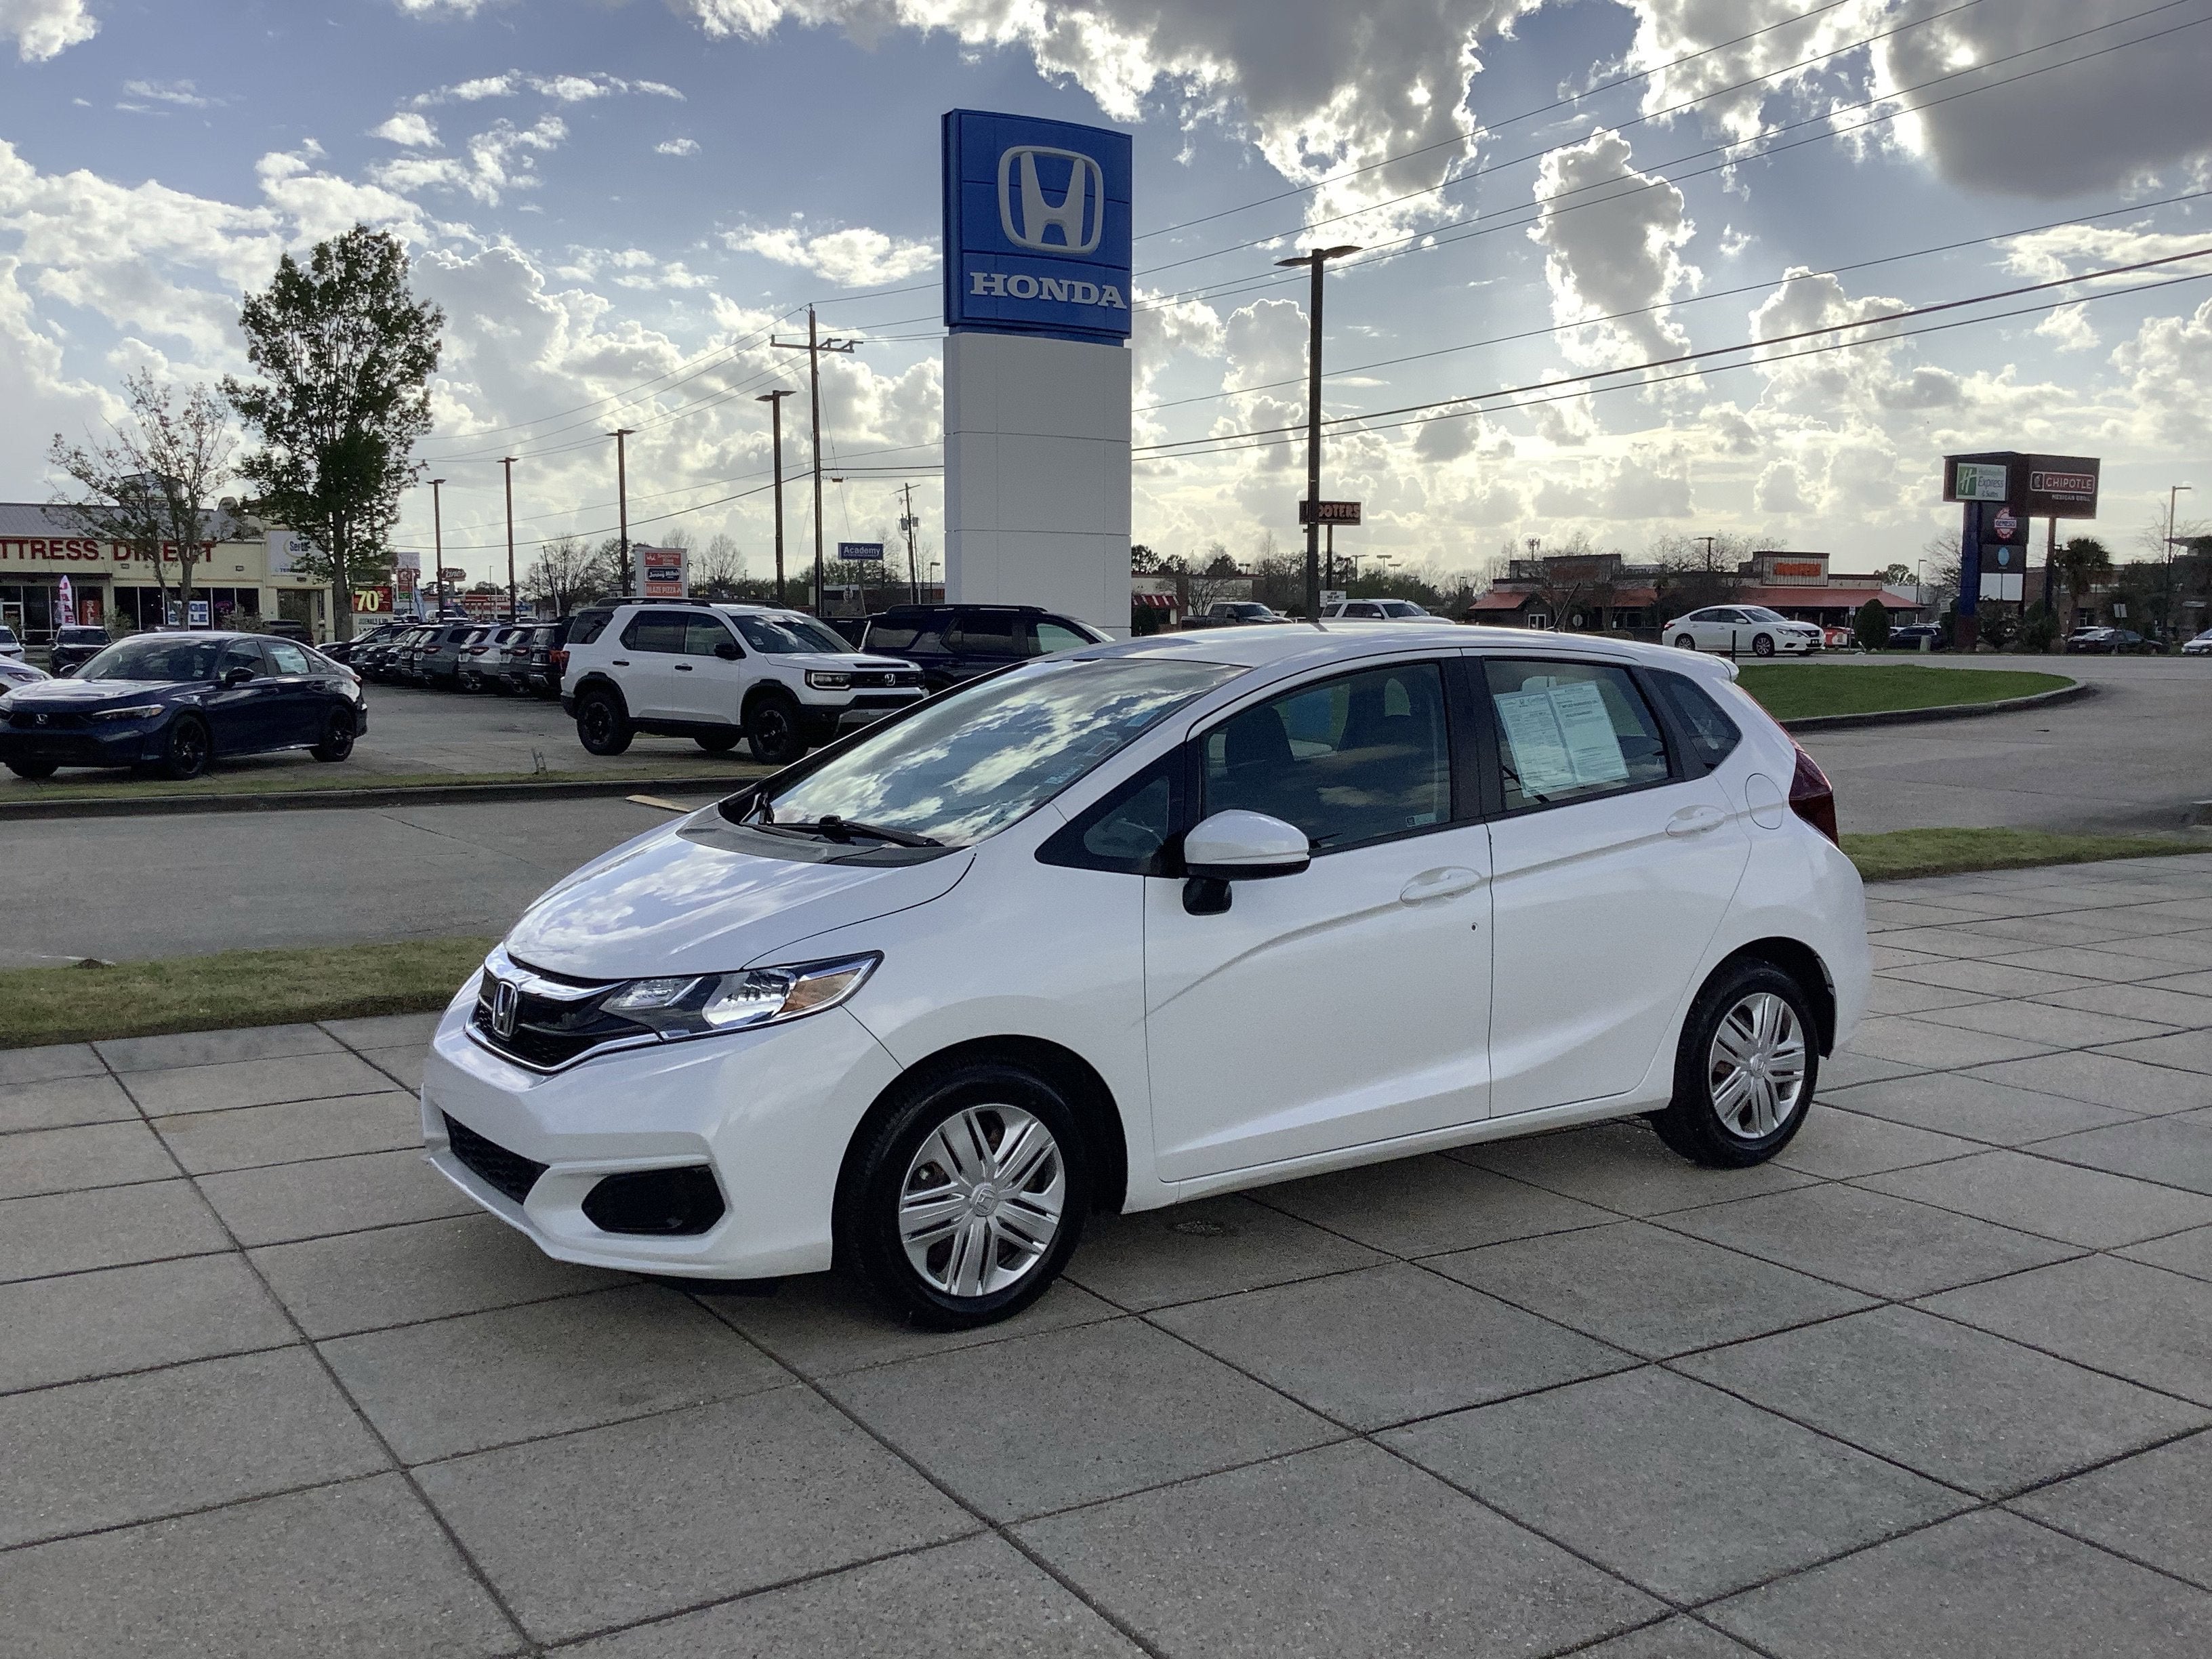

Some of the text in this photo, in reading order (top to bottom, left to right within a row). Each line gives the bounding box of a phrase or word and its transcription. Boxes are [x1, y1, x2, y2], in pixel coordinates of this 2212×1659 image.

[970, 272, 1127, 310] HONDA
[1978, 476, 2004, 489] Express
[2046, 477, 2092, 489] CHIPOTLE
[1311, 504, 1360, 518] OOTERS
[844, 546, 880, 556] Academy
[169, 614, 207, 622] SLE
